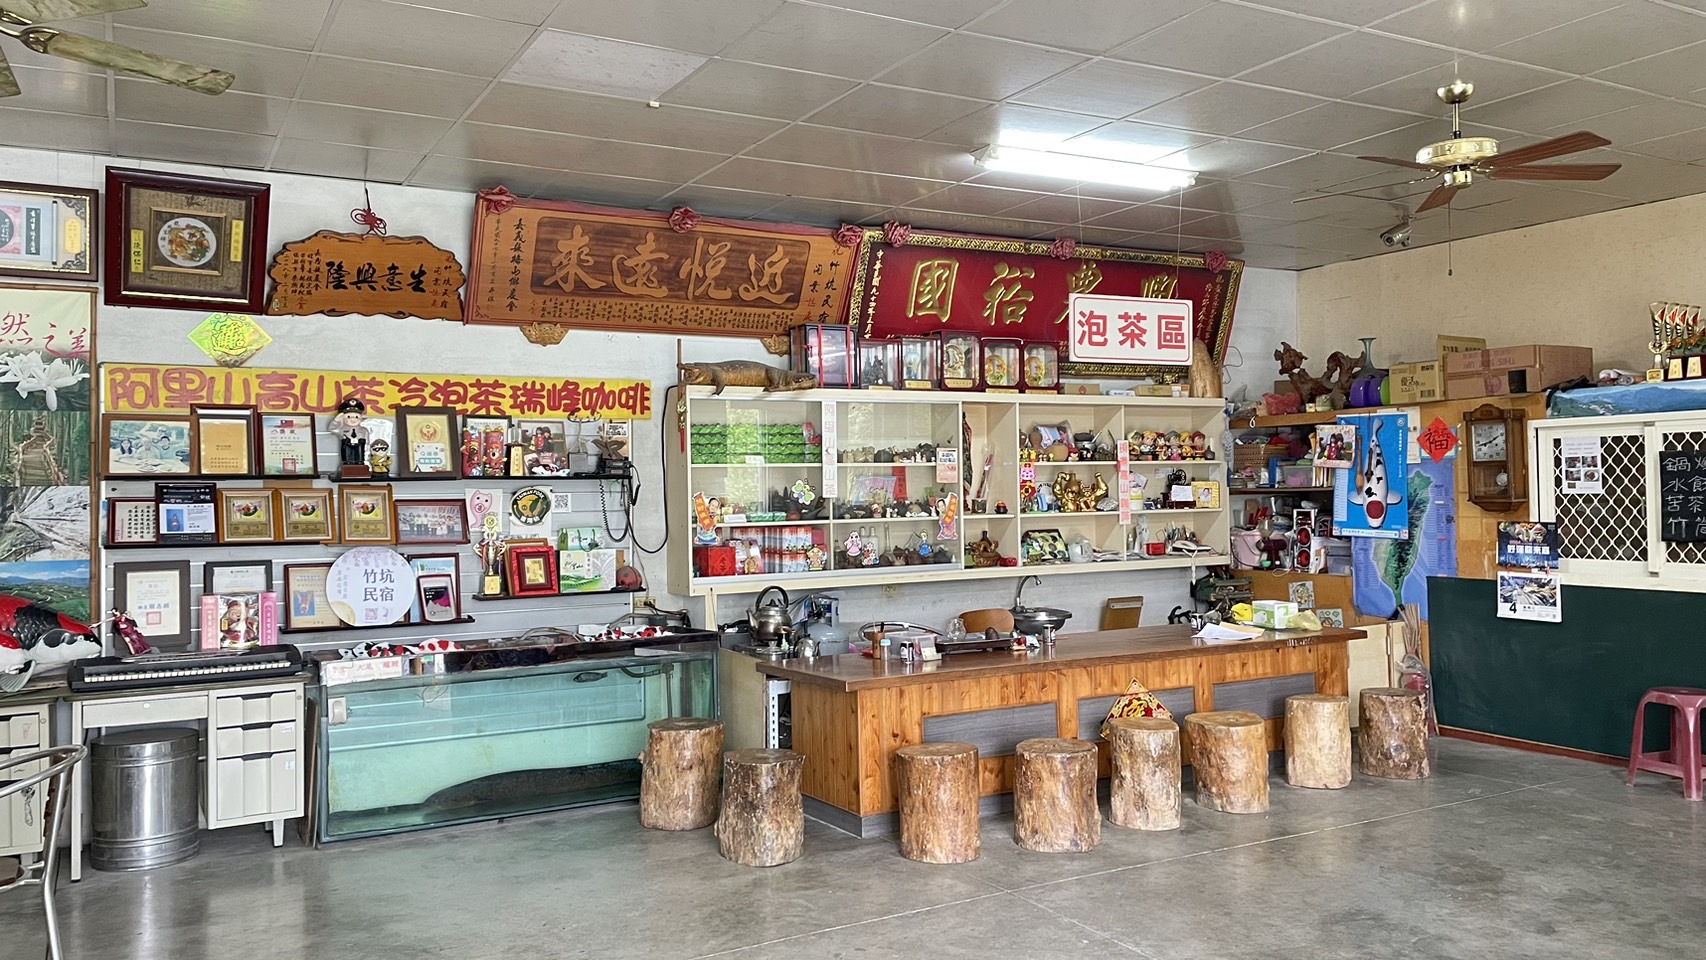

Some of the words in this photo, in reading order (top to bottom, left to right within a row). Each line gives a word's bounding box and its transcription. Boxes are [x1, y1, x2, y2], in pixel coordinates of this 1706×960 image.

[325, 260, 428, 294] 生意興隆
[1077, 310, 1187, 350] 泡茶區
[108, 367, 650, 416] 阿里山高山茶冷泡茶瑞峰咖啡
[1425, 428, 1450, 453] 福
[363, 568, 395, 583] 竹坑
[363, 587, 395, 602] 民宿
[1509, 601, 1518, 614] 4
